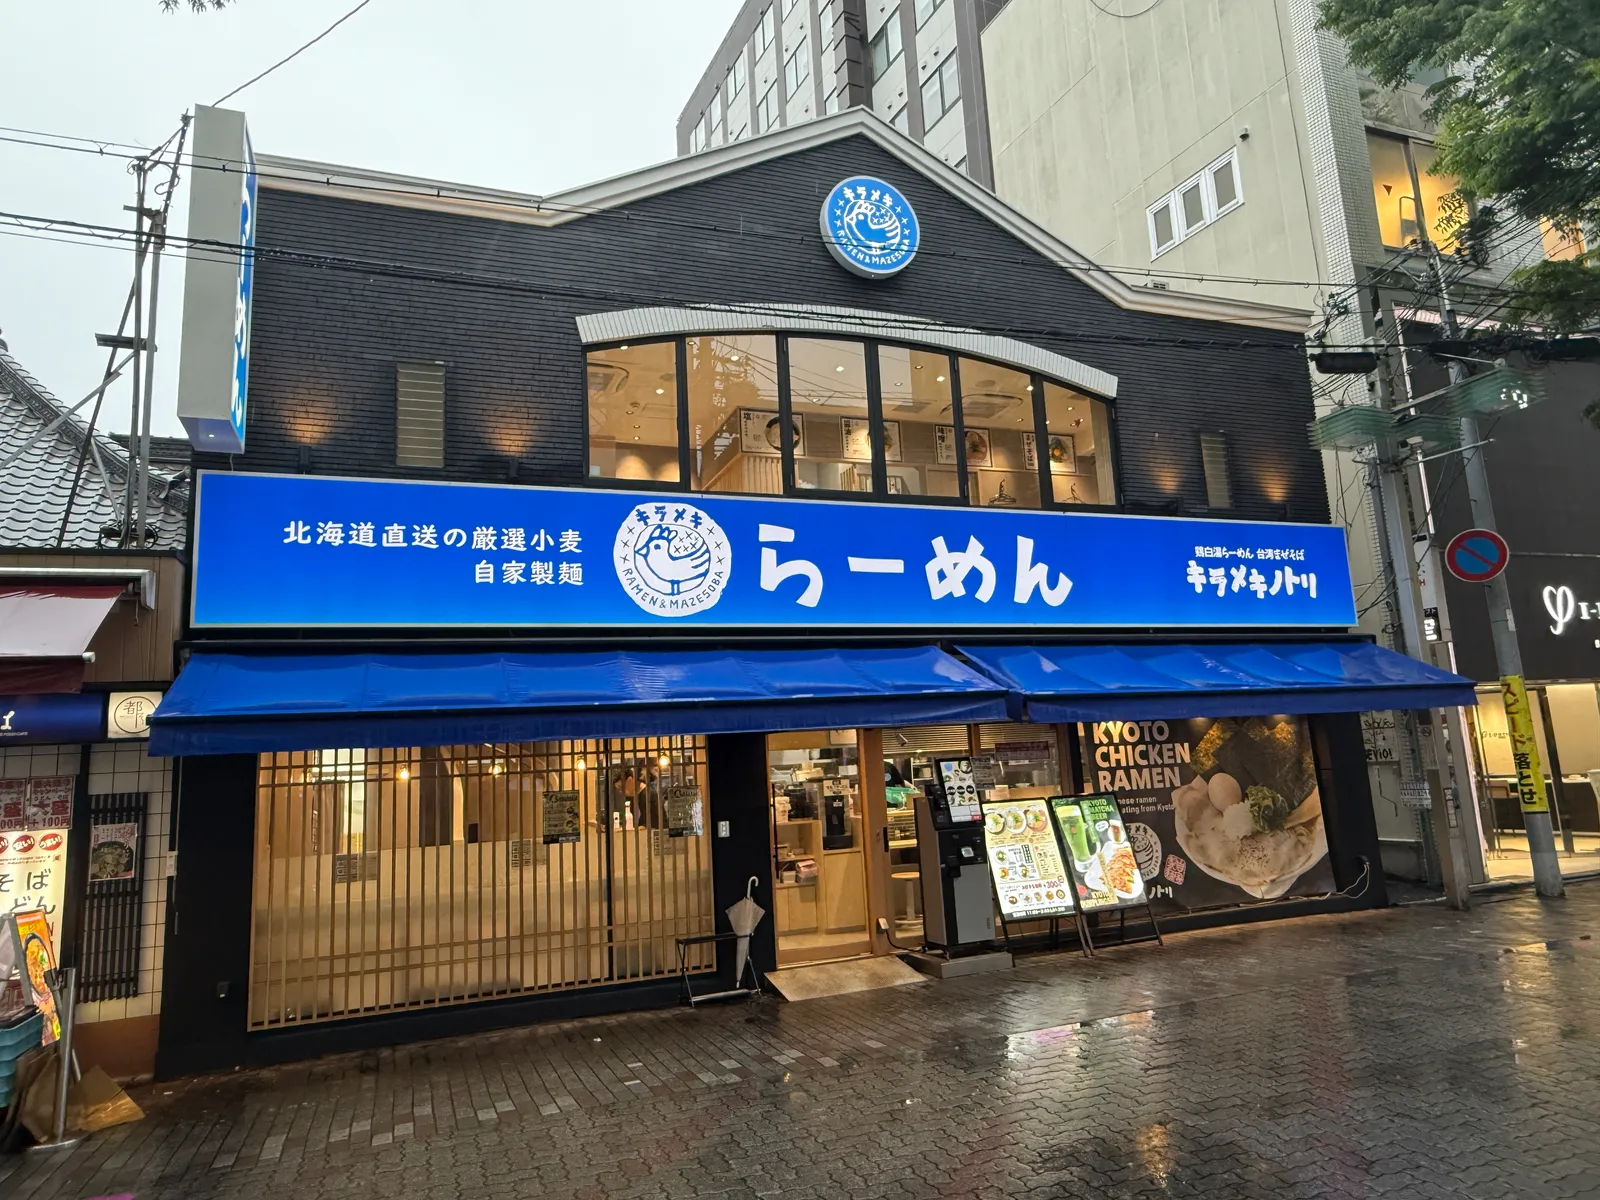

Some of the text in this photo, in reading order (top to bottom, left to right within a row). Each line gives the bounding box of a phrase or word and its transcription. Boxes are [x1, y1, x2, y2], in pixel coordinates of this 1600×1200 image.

[843, 186, 893, 207] キラメキ
[635, 505, 703, 529] キラメキ
[282, 519, 584, 555] 北海道直送の厳選小麦
[473, 559, 585, 587] 自家製麺
[758, 522, 1073, 608] らーめん
[622, 567, 724, 609] RAMEN&MAZESOBA
[1186, 559, 1317, 599] キラメキノトリ
[1092, 720, 1169, 744] KYOTO
[1500, 682, 1537, 806] スピード落とせ
[1095, 742, 1191, 768] CHICKEN
[1097, 766, 1181, 793] RAMEN
[1136, 796, 1157, 804] ramen
[1140, 804, 1156, 813] from
[0, 818, 23, 830] 00円
